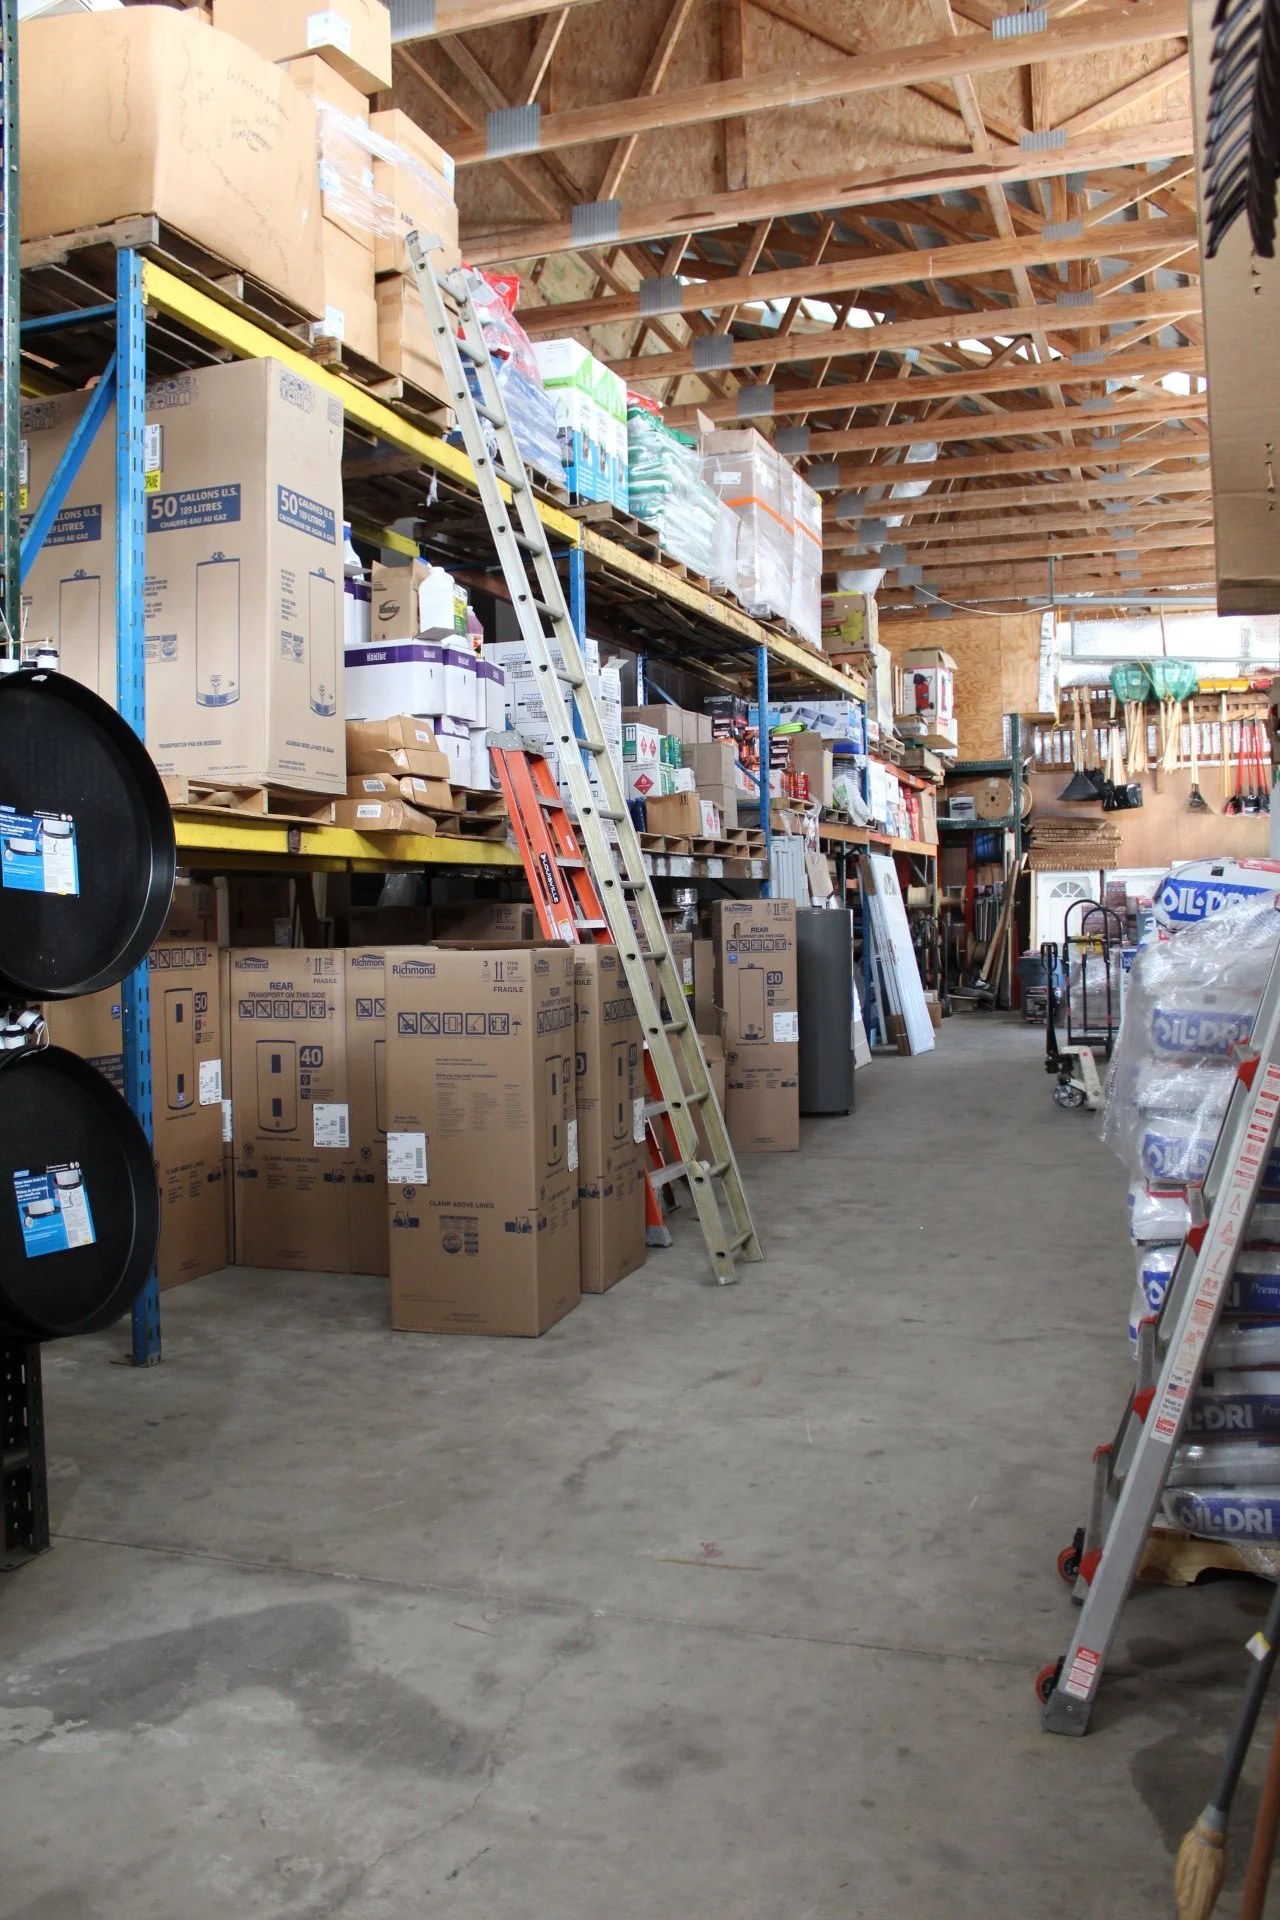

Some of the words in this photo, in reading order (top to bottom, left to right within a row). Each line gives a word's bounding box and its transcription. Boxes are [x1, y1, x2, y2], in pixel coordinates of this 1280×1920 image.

[179, 489, 220, 503] GALLONS
[221, 487, 239, 498] U.S.
[151, 496, 178, 520] 50
[180, 506, 193, 516] 189
[193, 501, 223, 514] LITRES
[280, 489, 298, 515] 50
[59, 511, 81, 523] LLONS
[213, 513, 229, 521] GAZ
[57, 521, 85, 533] LITRES
[542, 859, 559, 904] LOUISVILLE
[234, 958, 269, 970] Richmond
[351, 957, 385, 967] Richmon
[392, 963, 436, 976] Richmond
[767, 972, 782, 984] 30
[269, 981, 294, 991] REAR
[248, 991, 286, 999] TRANSPORT
[195, 994, 208, 1011] 50
[300, 1048, 322, 1066] 40
[451, 1201, 474, 1209] ABOVE
[1155, 1421, 1174, 1435] Giant
[1157, 1415, 1176, 1428] Little
